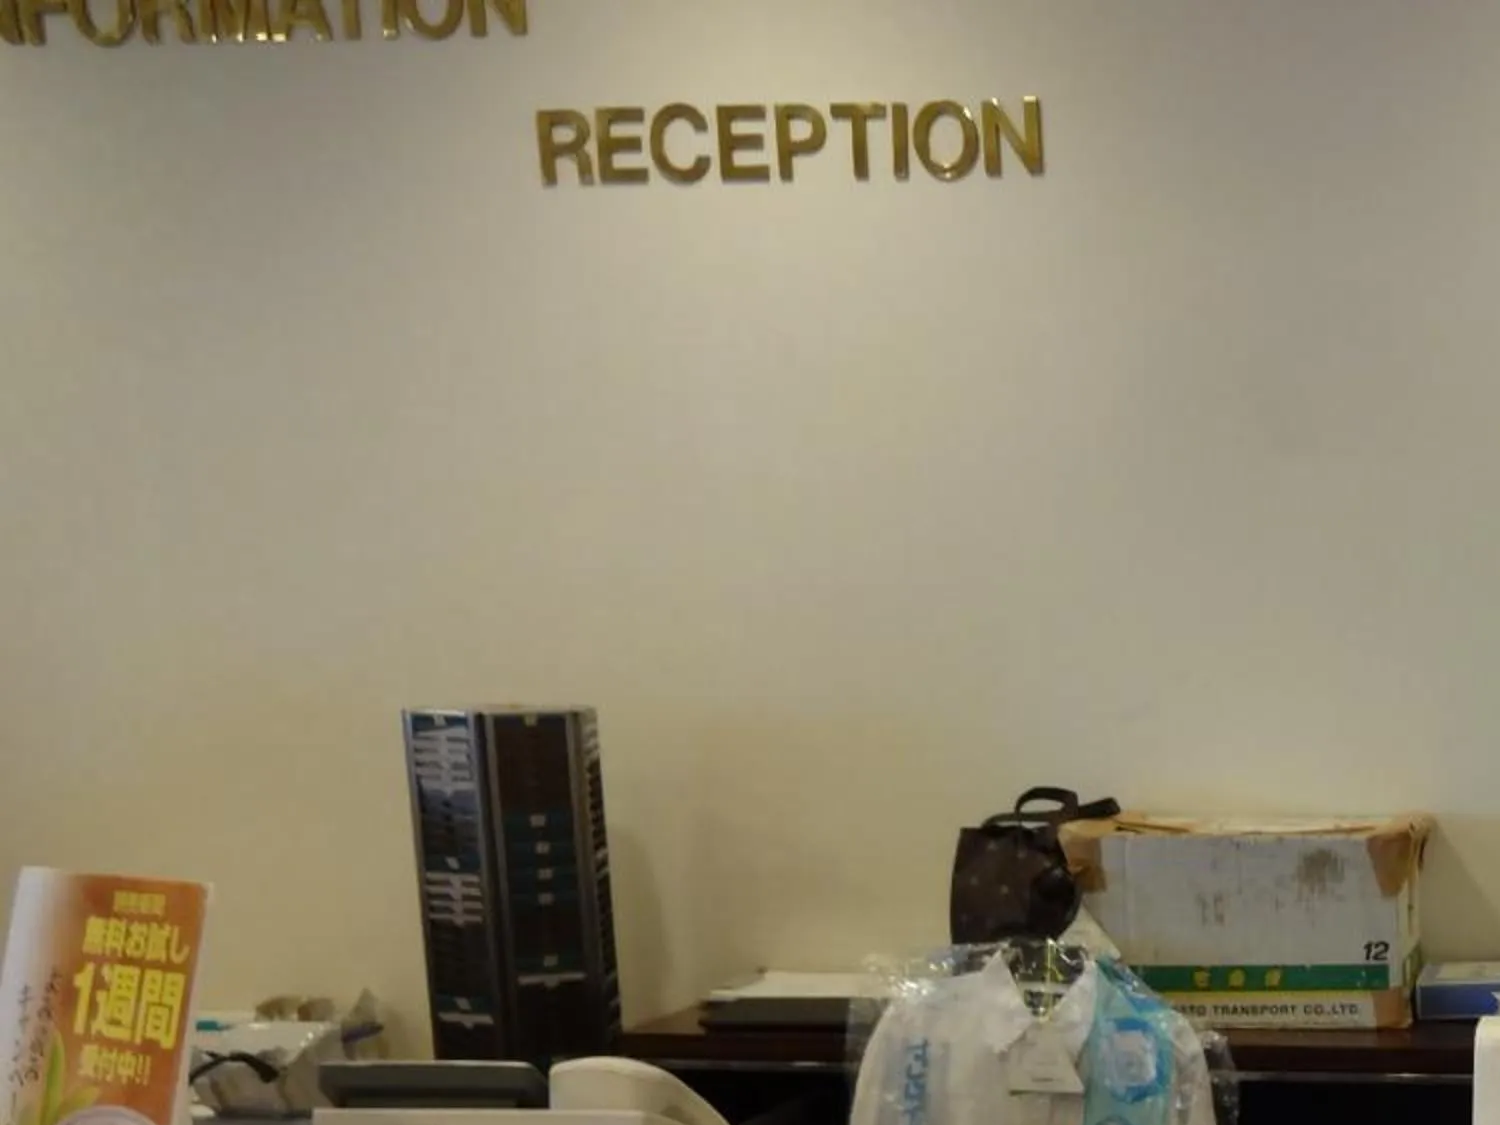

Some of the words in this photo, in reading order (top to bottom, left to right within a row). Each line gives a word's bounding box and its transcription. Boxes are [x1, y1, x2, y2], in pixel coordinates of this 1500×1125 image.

[0, 0, 527, 48] FORMATION
[534, 96, 1045, 186] RECEPTION
[1364, 941, 1390, 961] 12
[73, 962, 187, 1051] 1週間
[1212, 1004, 1297, 1017] TRANSPORT
